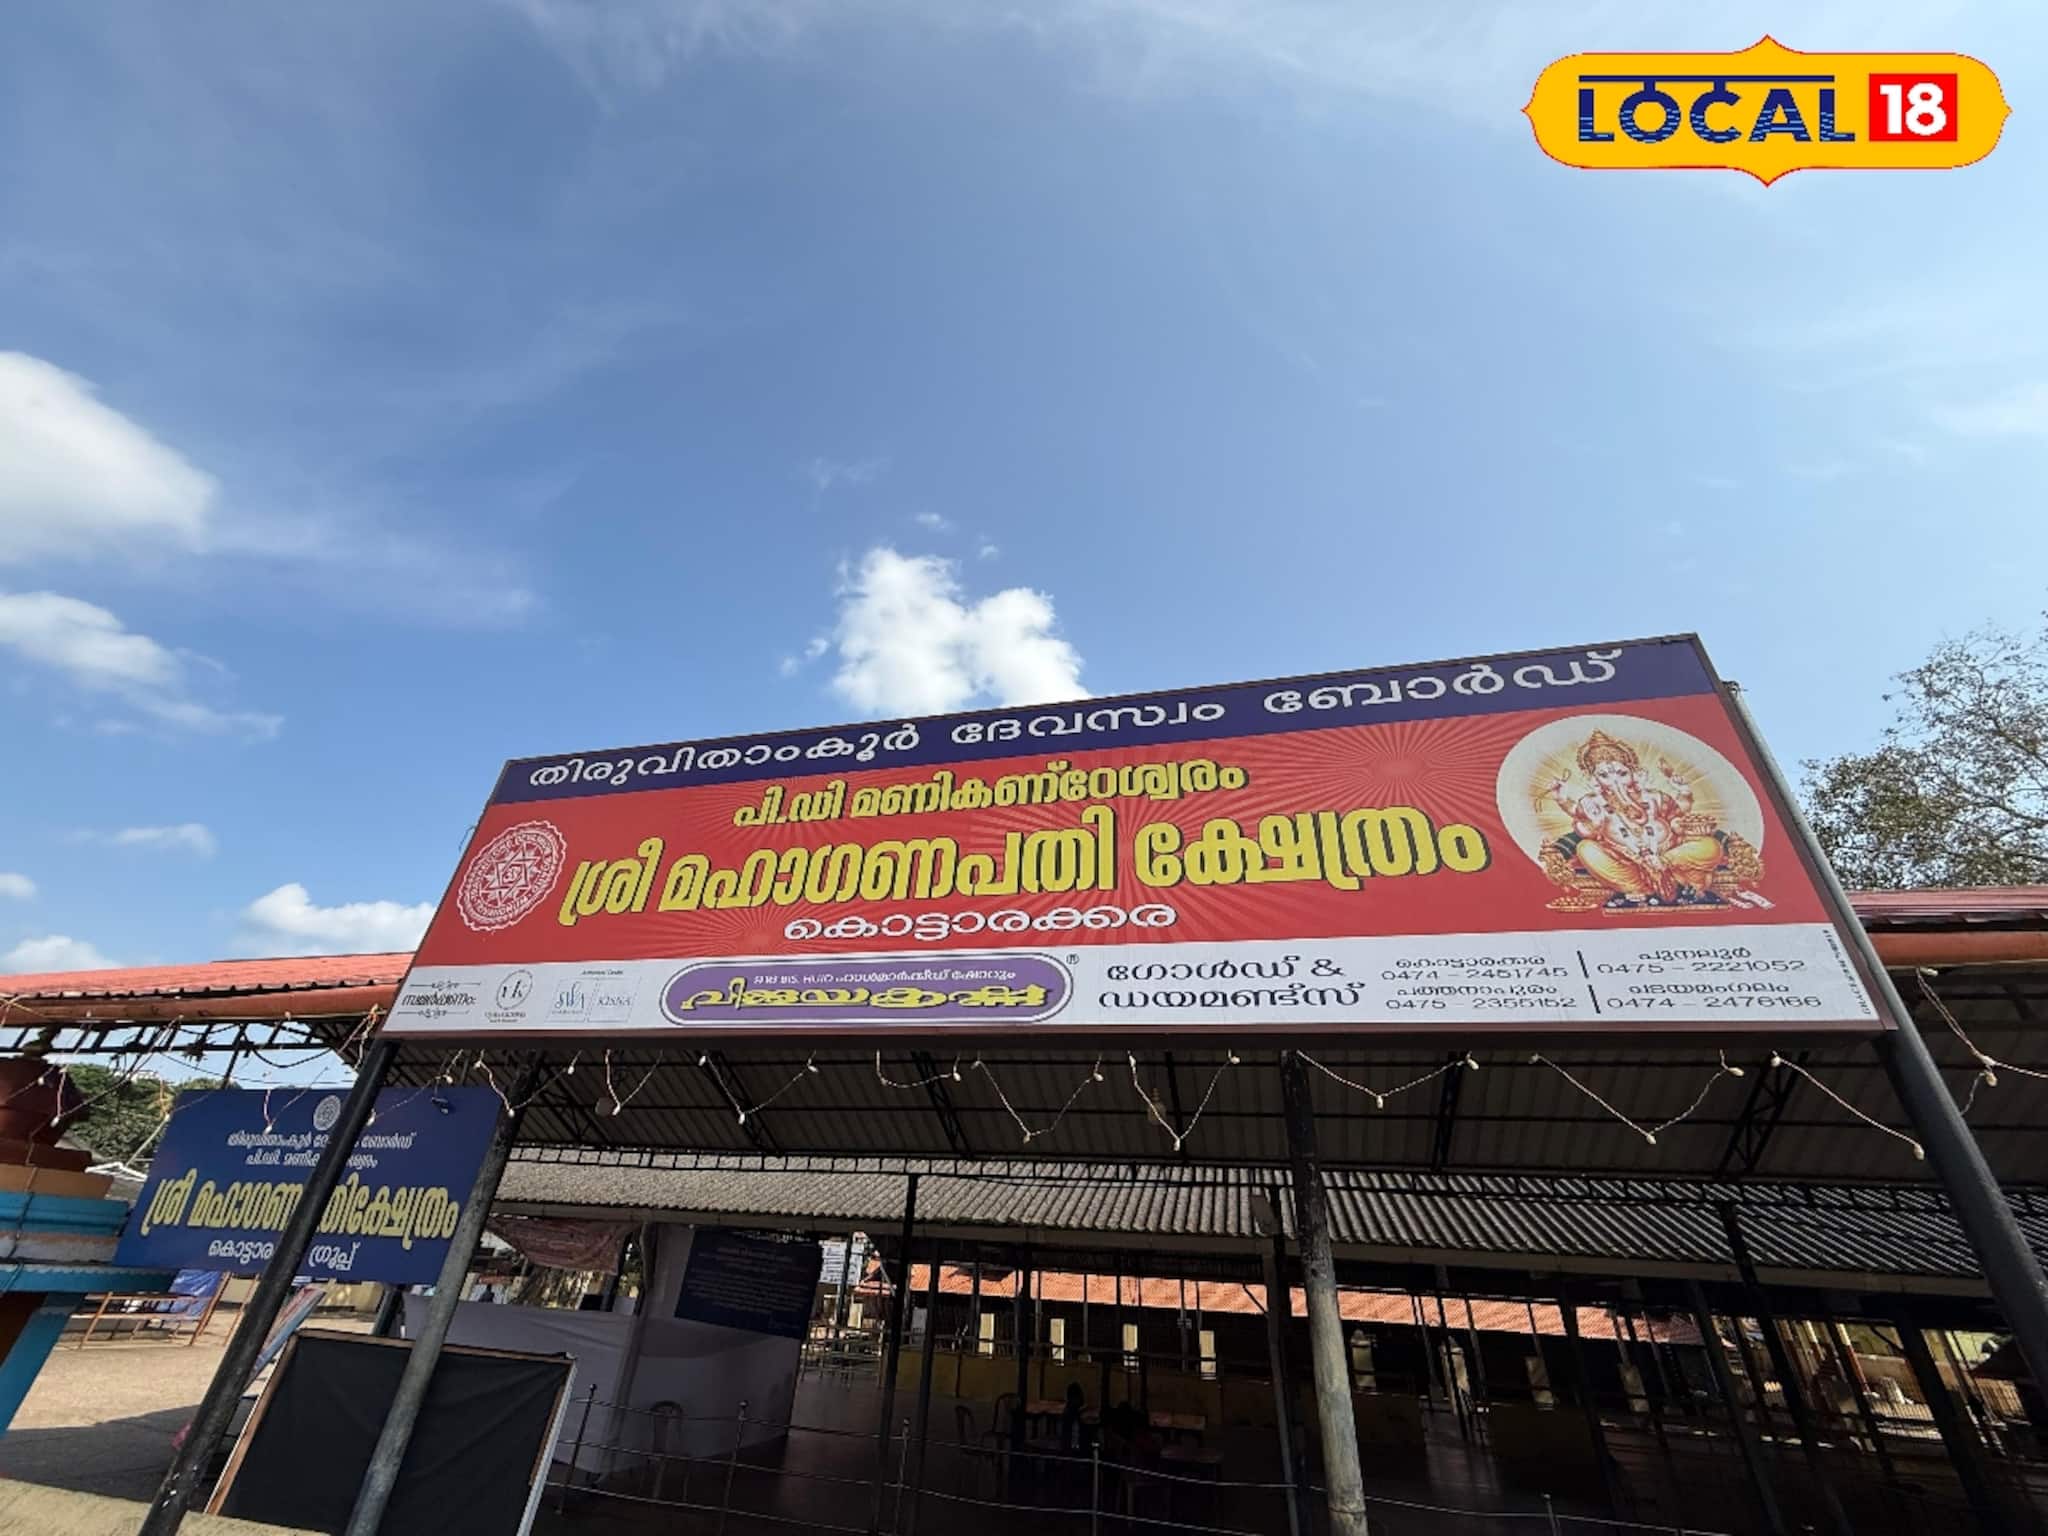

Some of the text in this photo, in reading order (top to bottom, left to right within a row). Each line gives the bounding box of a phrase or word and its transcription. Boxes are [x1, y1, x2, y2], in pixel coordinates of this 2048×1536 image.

[529, 648, 1623, 787] തിരുവിതാംകൂർ ദേവസ്വം ബോർഡ്
[732, 780, 848, 828] പി.ഡി
[558, 836, 665, 926] ശ്രീ
[657, 804, 1117, 914] മഹാഗണപതി
[1133, 804, 1492, 892] ക്ഷേത്രം
[784, 903, 1179, 942] കൊട്ടാരക്കര
[1107, 955, 1347, 980] ഗോൾഡ് &
[1381, 970, 1440, 981] 0474
[1597, 963, 1665, 975] 0475
[1098, 982, 1366, 1008] ഡയമണ്ട്സ്
[1385, 999, 1447, 1010] 0475
[1607, 998, 1676, 1009] 0474
[140, 1168, 198, 1236] ശ്രീ
